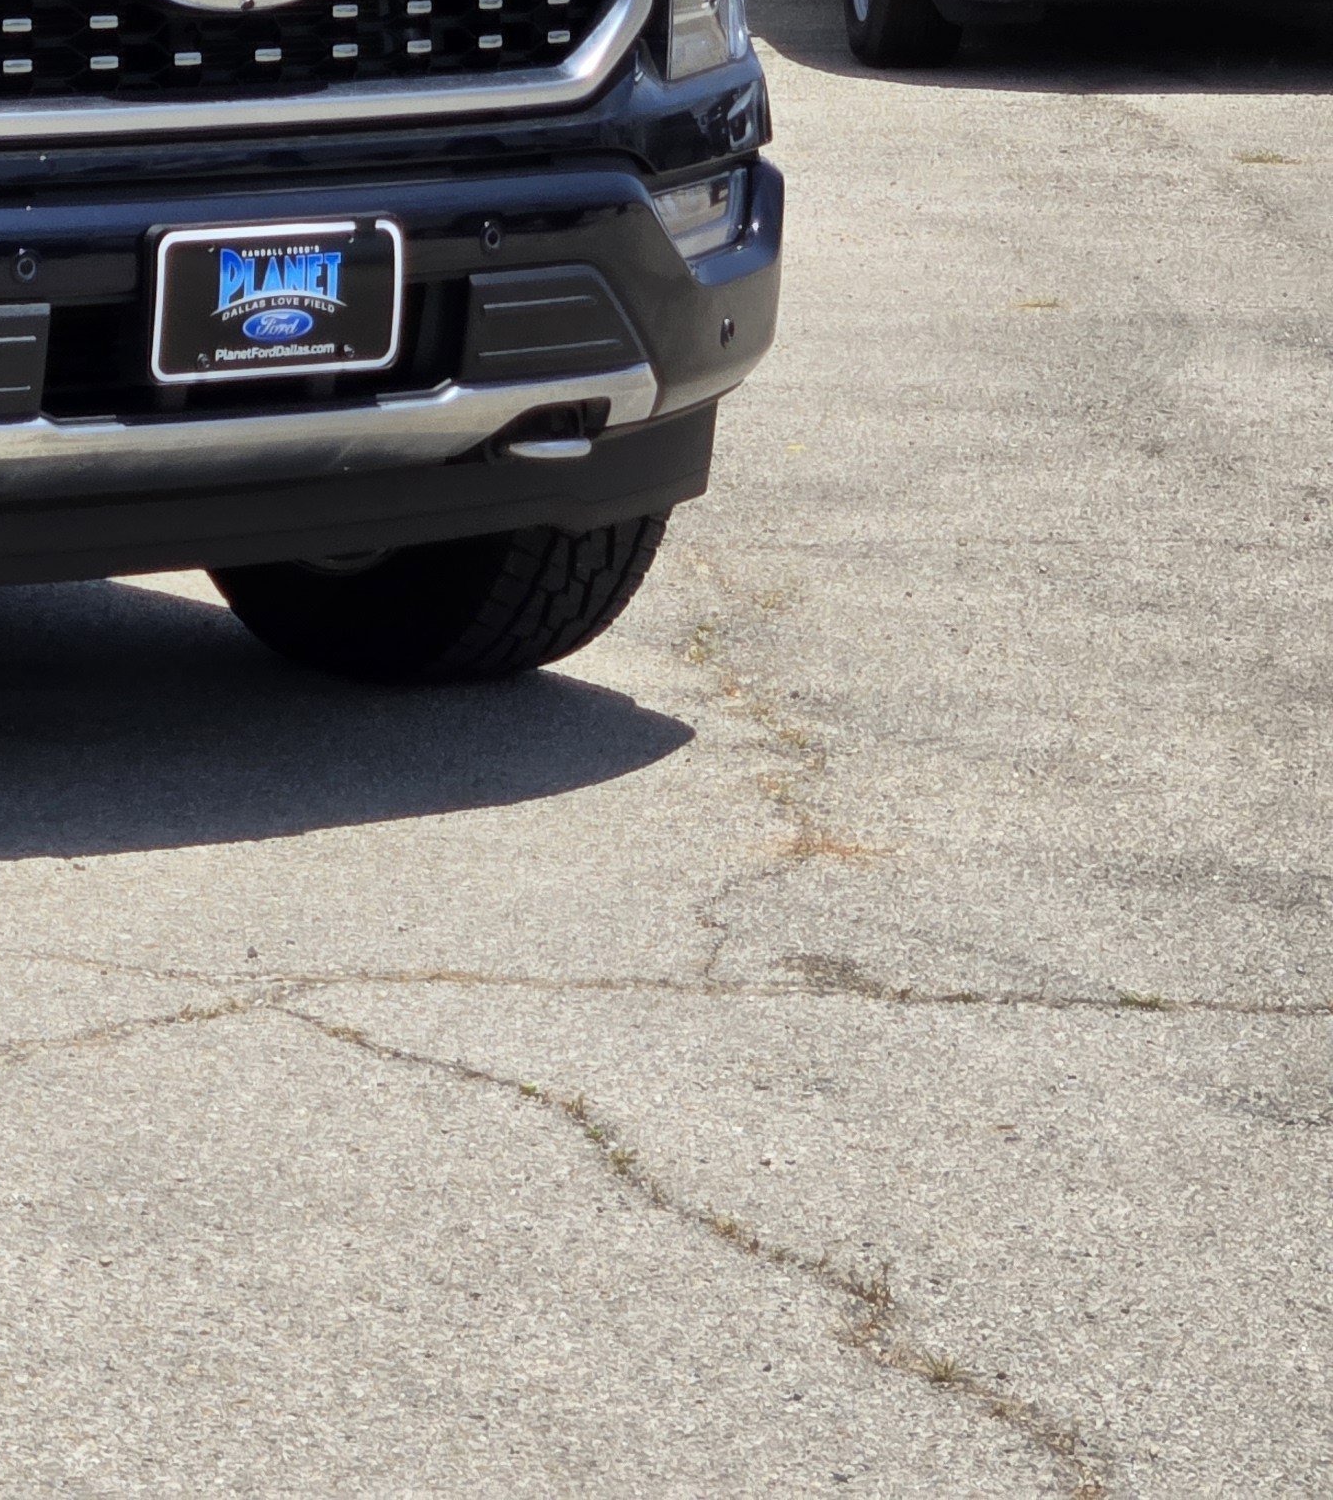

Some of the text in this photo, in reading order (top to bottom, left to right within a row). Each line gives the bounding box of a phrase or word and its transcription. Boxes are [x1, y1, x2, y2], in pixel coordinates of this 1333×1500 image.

[218, 248, 342, 311] PLANET
[221, 296, 336, 322] DALLAS LOVE FIELD
[255, 312, 301, 336] Ford
[214, 342, 336, 362] PlanetFordDallas.com
